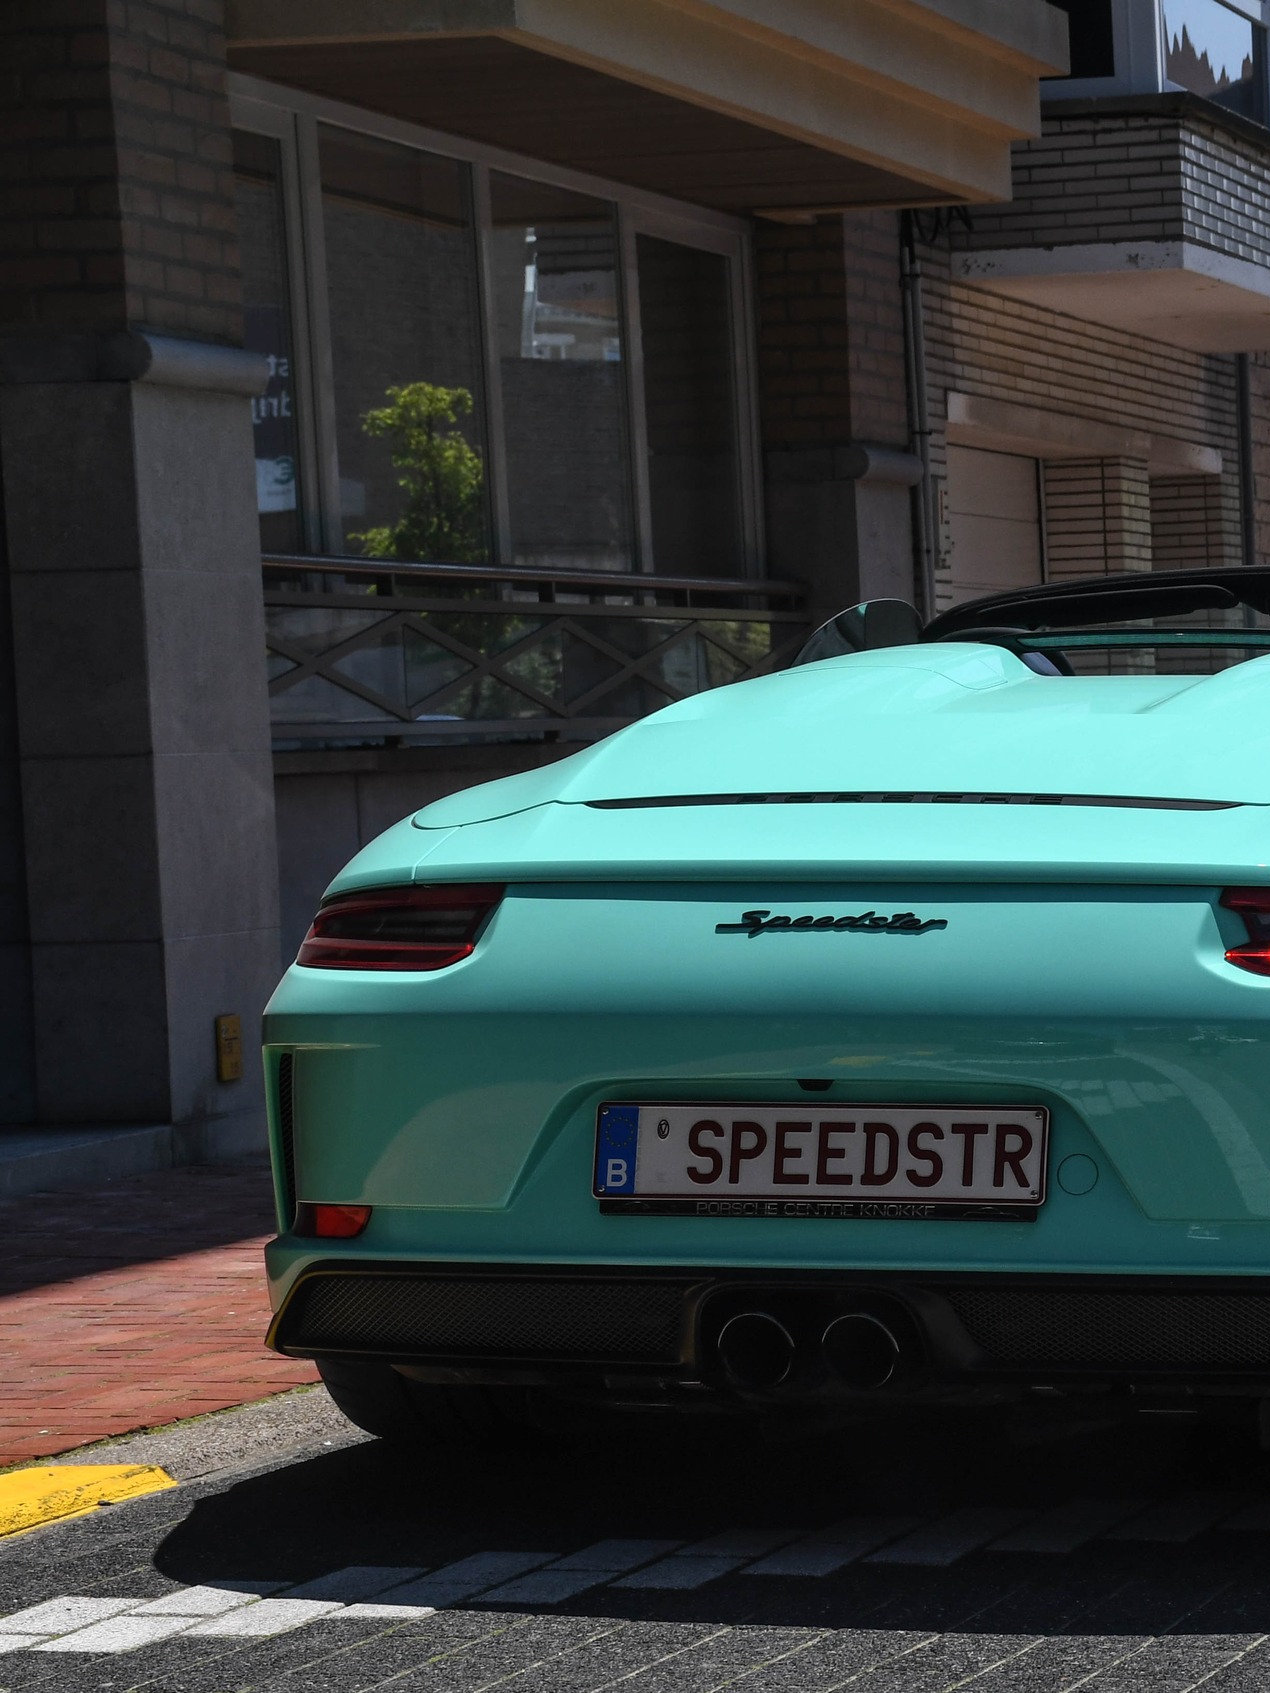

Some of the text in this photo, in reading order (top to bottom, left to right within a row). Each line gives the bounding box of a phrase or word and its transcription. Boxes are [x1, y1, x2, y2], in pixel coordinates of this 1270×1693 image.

[715, 910, 948, 939] Speedster
[687, 1120, 1033, 1188] SPEEDSTR
[606, 1159, 627, 1187] B
[696, 1202, 936, 1217] PORSCHE CENTRE KNOKKE
